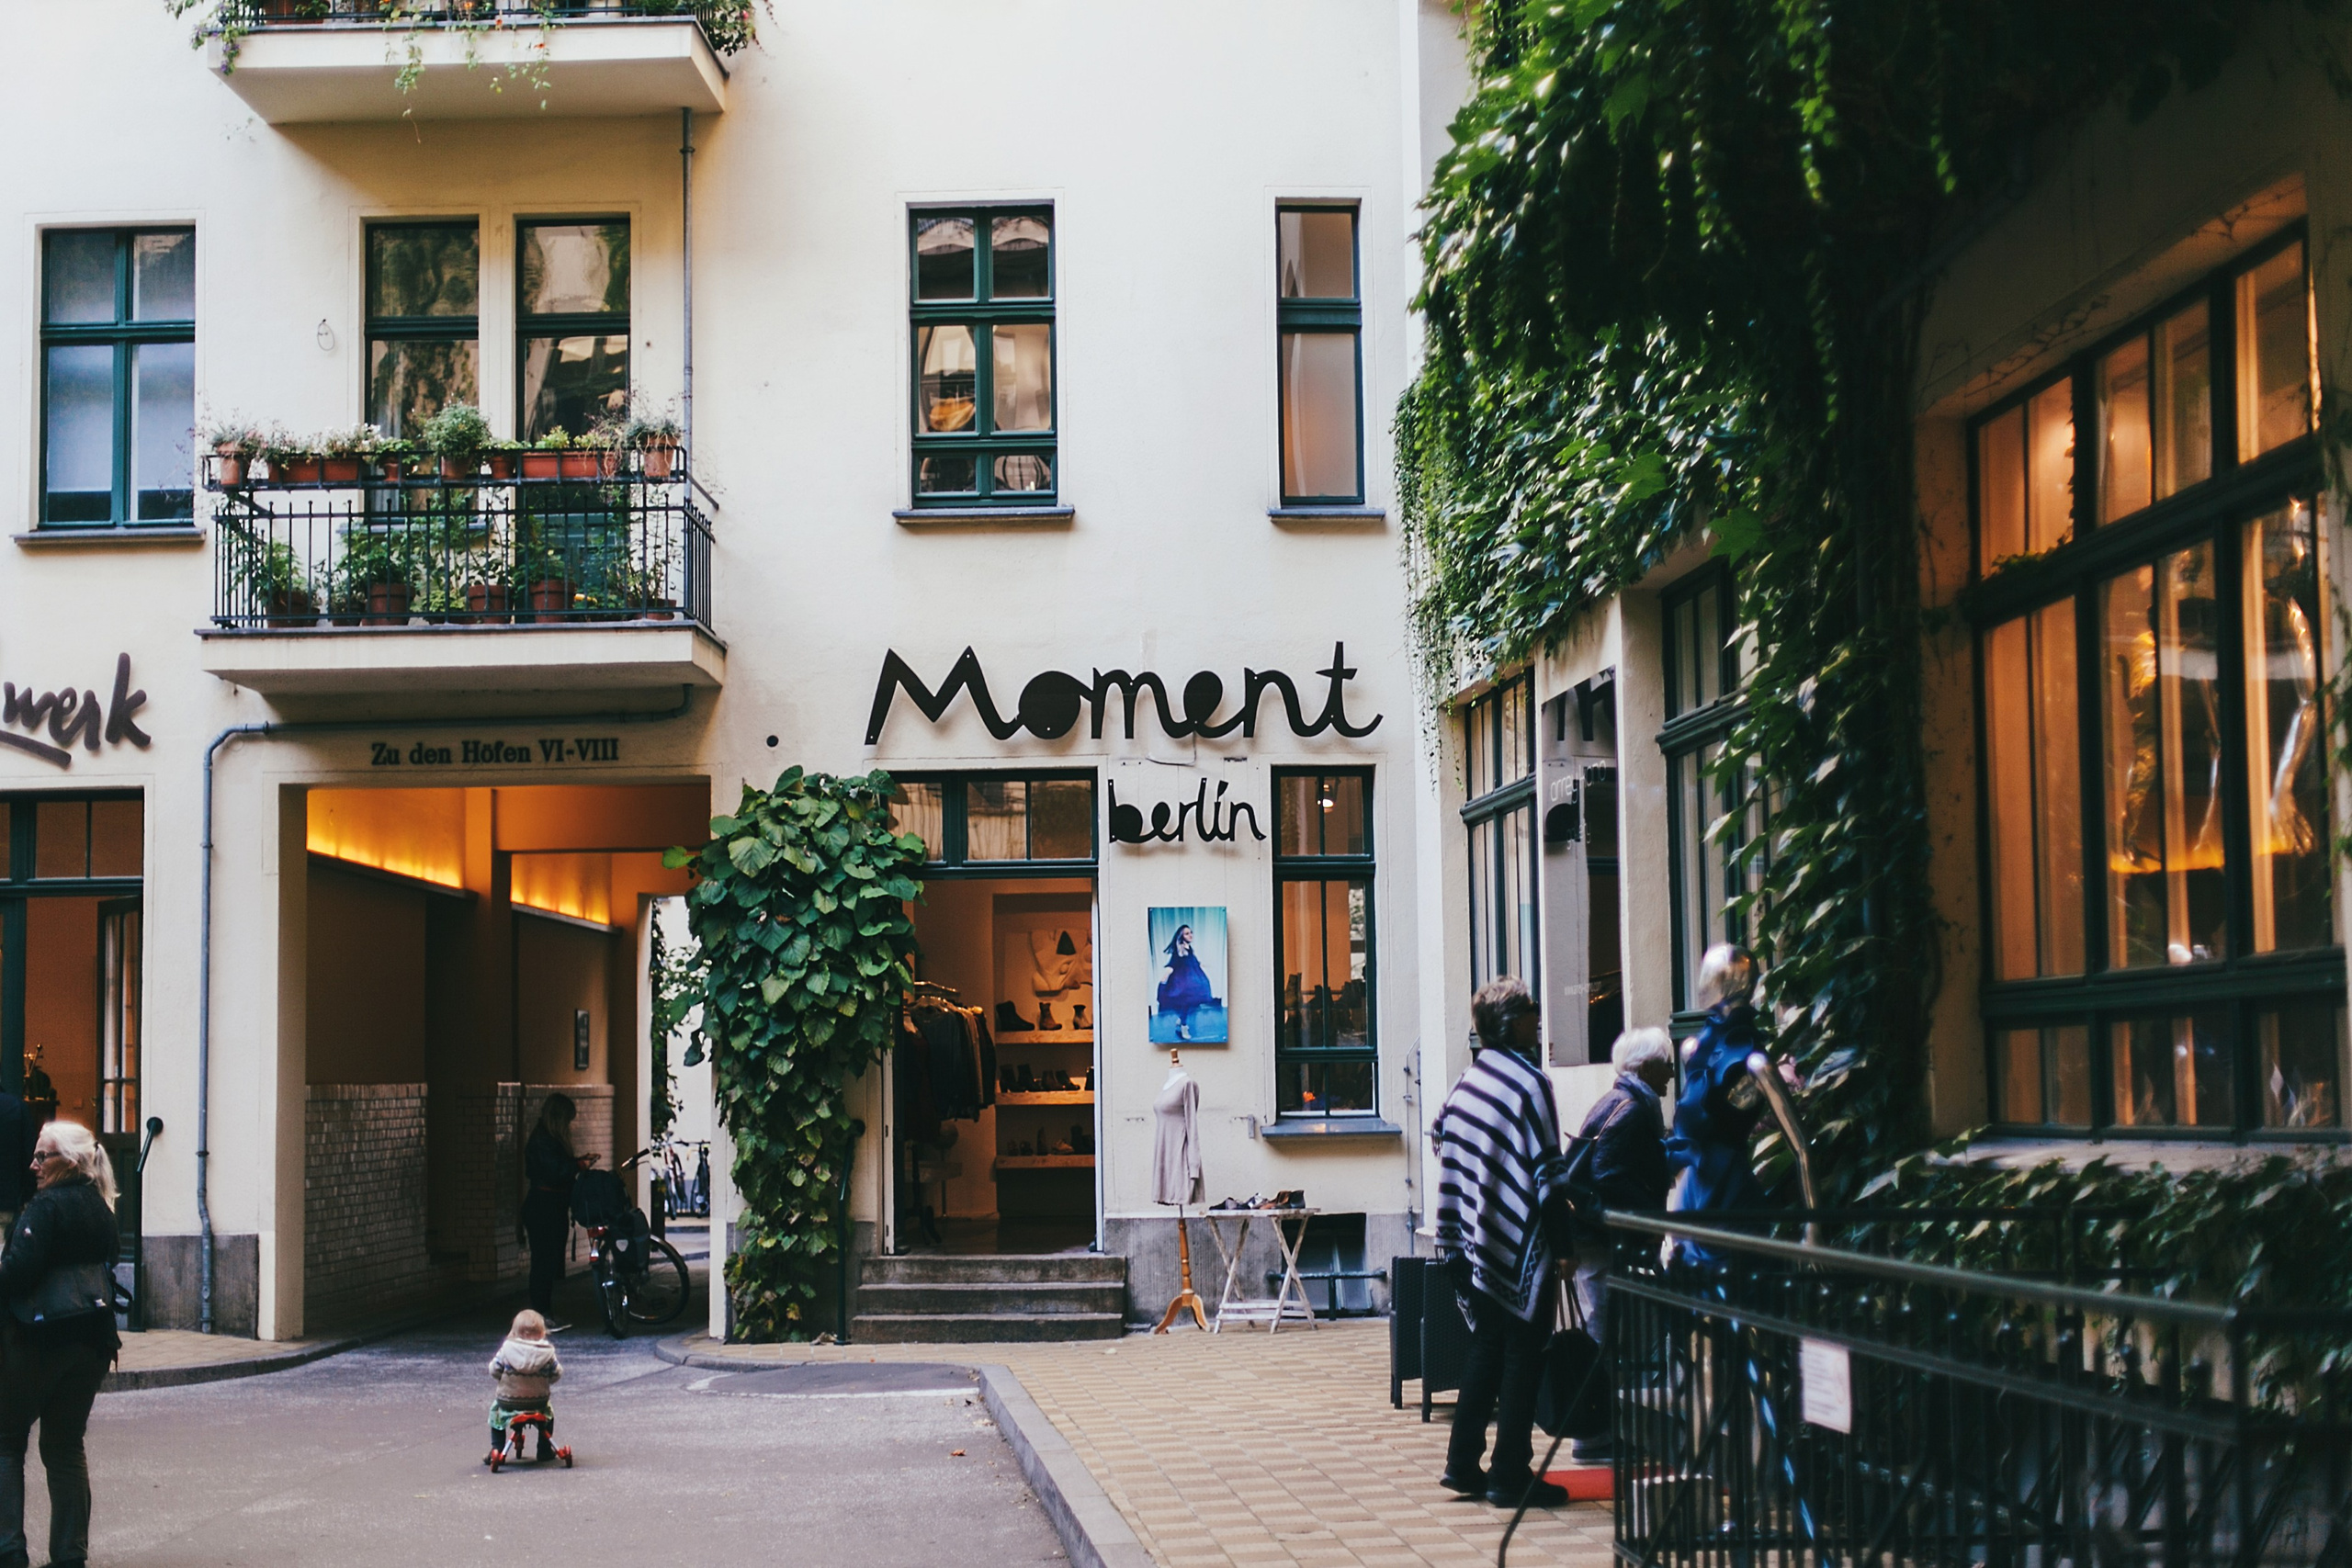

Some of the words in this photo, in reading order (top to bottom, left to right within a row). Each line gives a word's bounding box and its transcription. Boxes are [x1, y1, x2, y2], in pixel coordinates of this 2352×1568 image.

[3, 651, 152, 751] werk
[864, 640, 1385, 746] Moment
[370, 741, 401, 766] Zu
[408, 741, 452, 765] den
[460, 739, 532, 764] Höfen
[537, 738, 620, 762] VI-VIII
[1108, 776, 1268, 844] berlin
